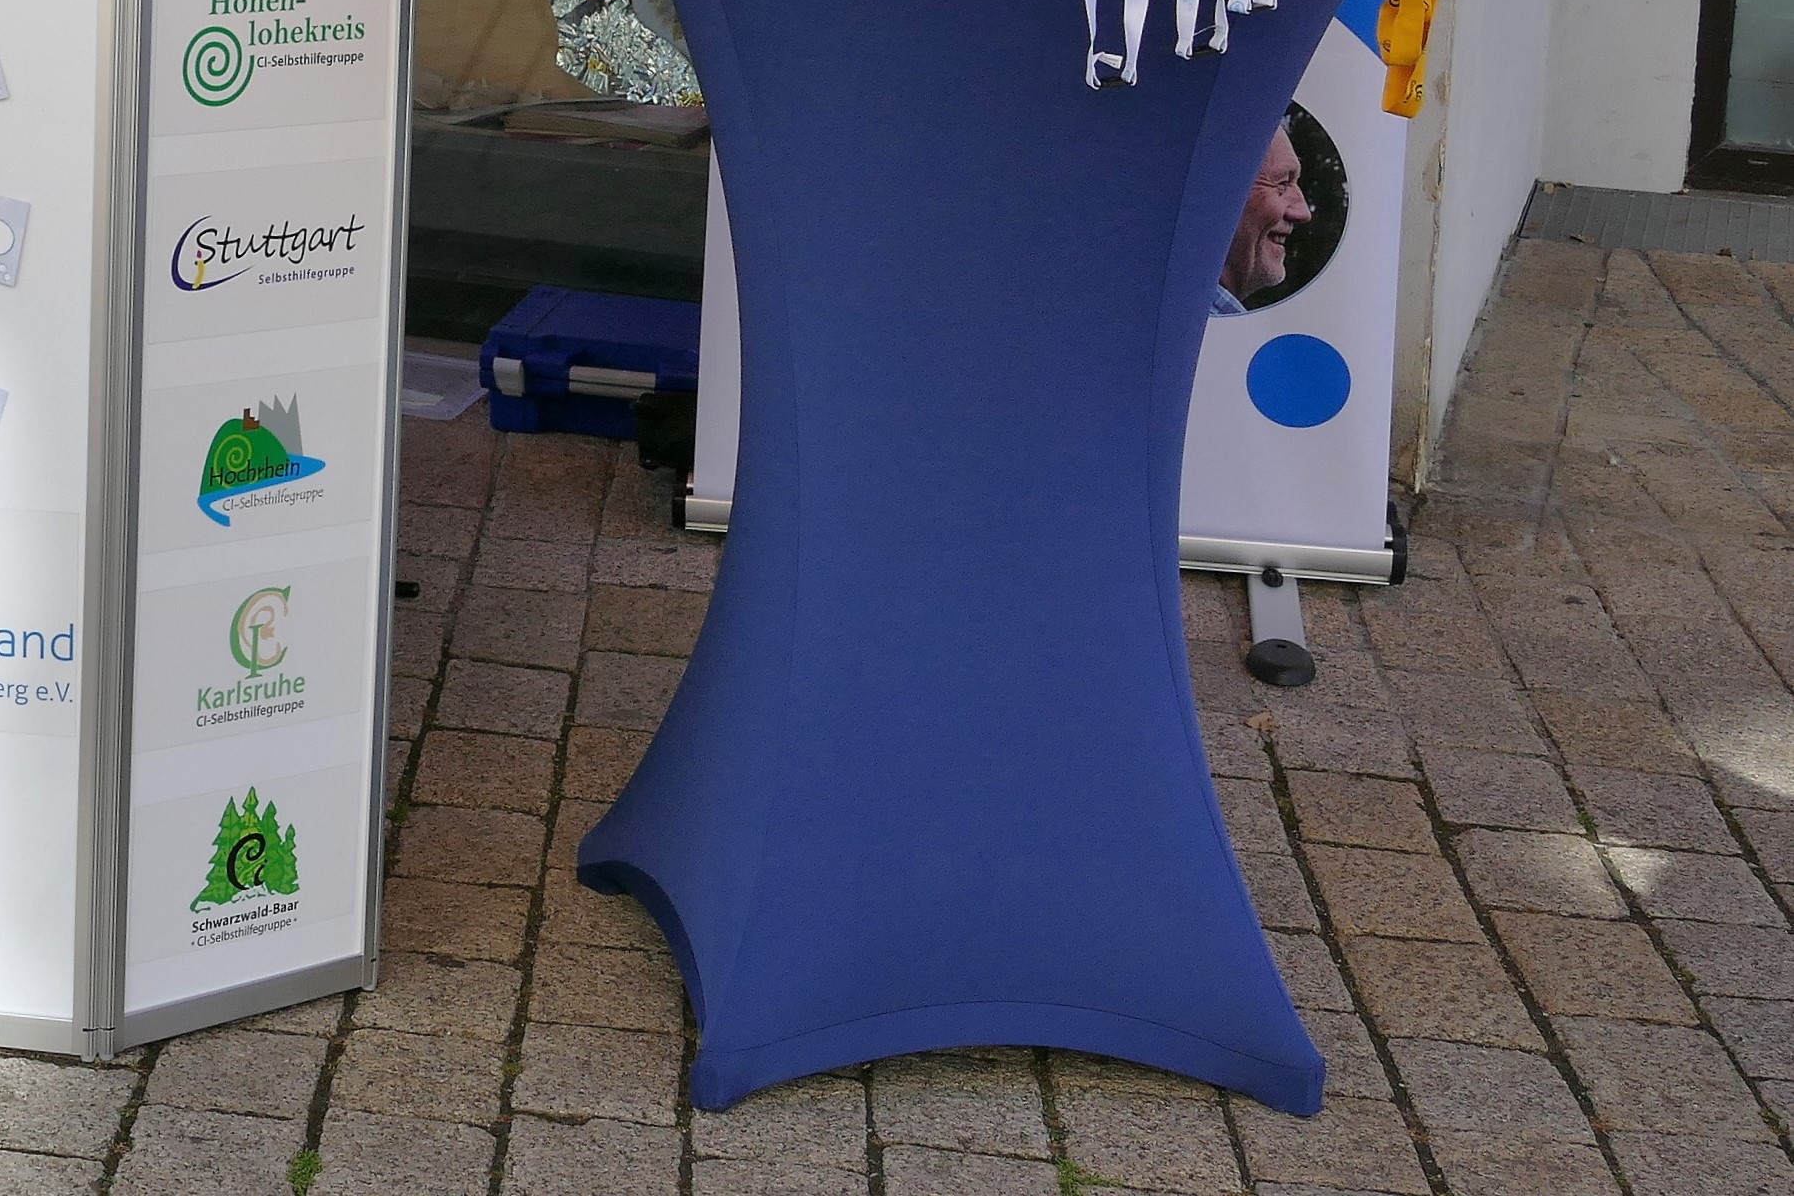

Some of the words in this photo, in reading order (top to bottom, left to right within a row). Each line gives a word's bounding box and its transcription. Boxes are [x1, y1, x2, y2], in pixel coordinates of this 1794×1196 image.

[248, 15, 365, 46] lohekreis
[256, 51, 364, 69] CI-Selbsthilfegruppe
[195, 213, 365, 265] Stuttgart
[258, 265, 355, 285] Selbsthilfegruppe
[209, 456, 301, 487] Hochrhein
[222, 487, 324, 512] CI-Selbsthilfegruppe
[35, 680, 74, 704] e.V.
[197, 673, 305, 711] Karlsruhe
[196, 699, 305, 728] CI-Selbsthilfegruppe
[191, 900, 299, 933] Schwarzwald-Baar
[197, 918, 292, 947] CI-Selbsthilfegruppe
